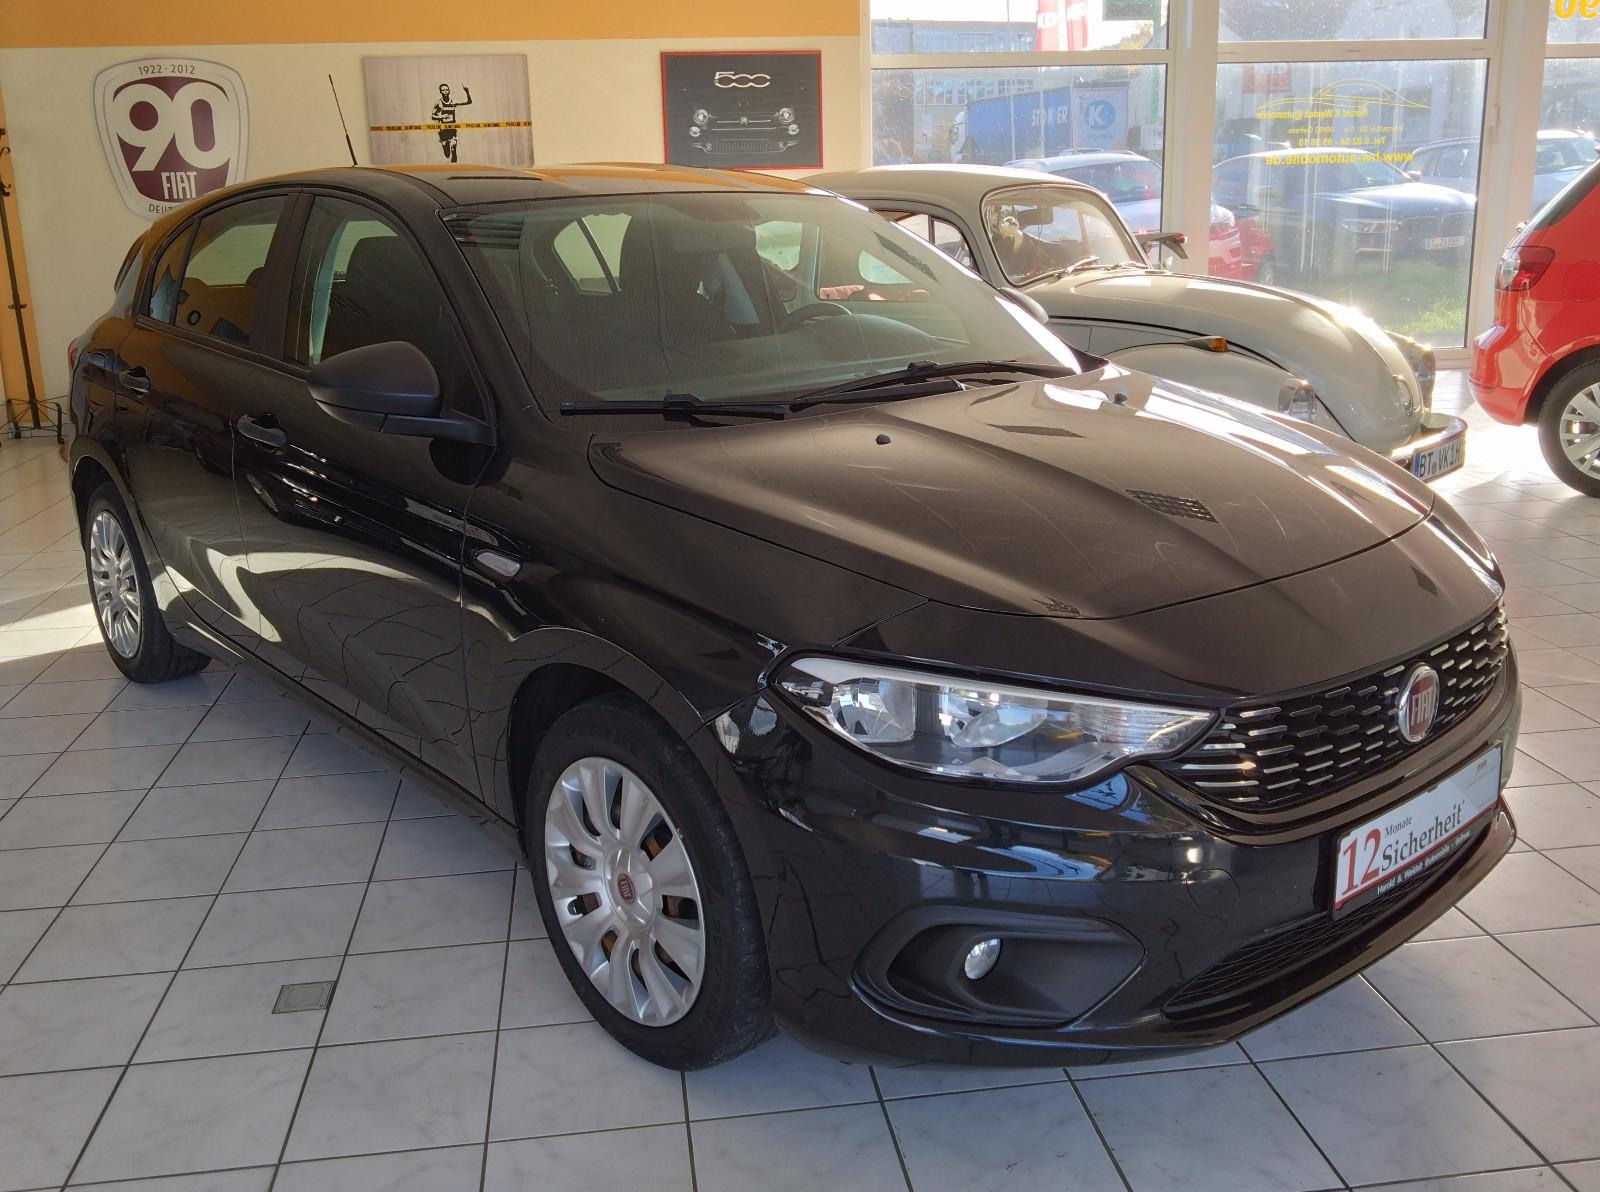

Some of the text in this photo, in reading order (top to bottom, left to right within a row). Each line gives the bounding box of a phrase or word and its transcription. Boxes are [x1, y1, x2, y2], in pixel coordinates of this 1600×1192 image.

[714, 71, 771, 88] 500
[112, 82, 231, 172] 90
[161, 171, 199, 200] FIAT
[1411, 686, 1434, 726] FIAT
[1381, 804, 1463, 872] Sicherheit
[1384, 814, 1413, 838] Monate
[1341, 827, 1382, 896] 12
